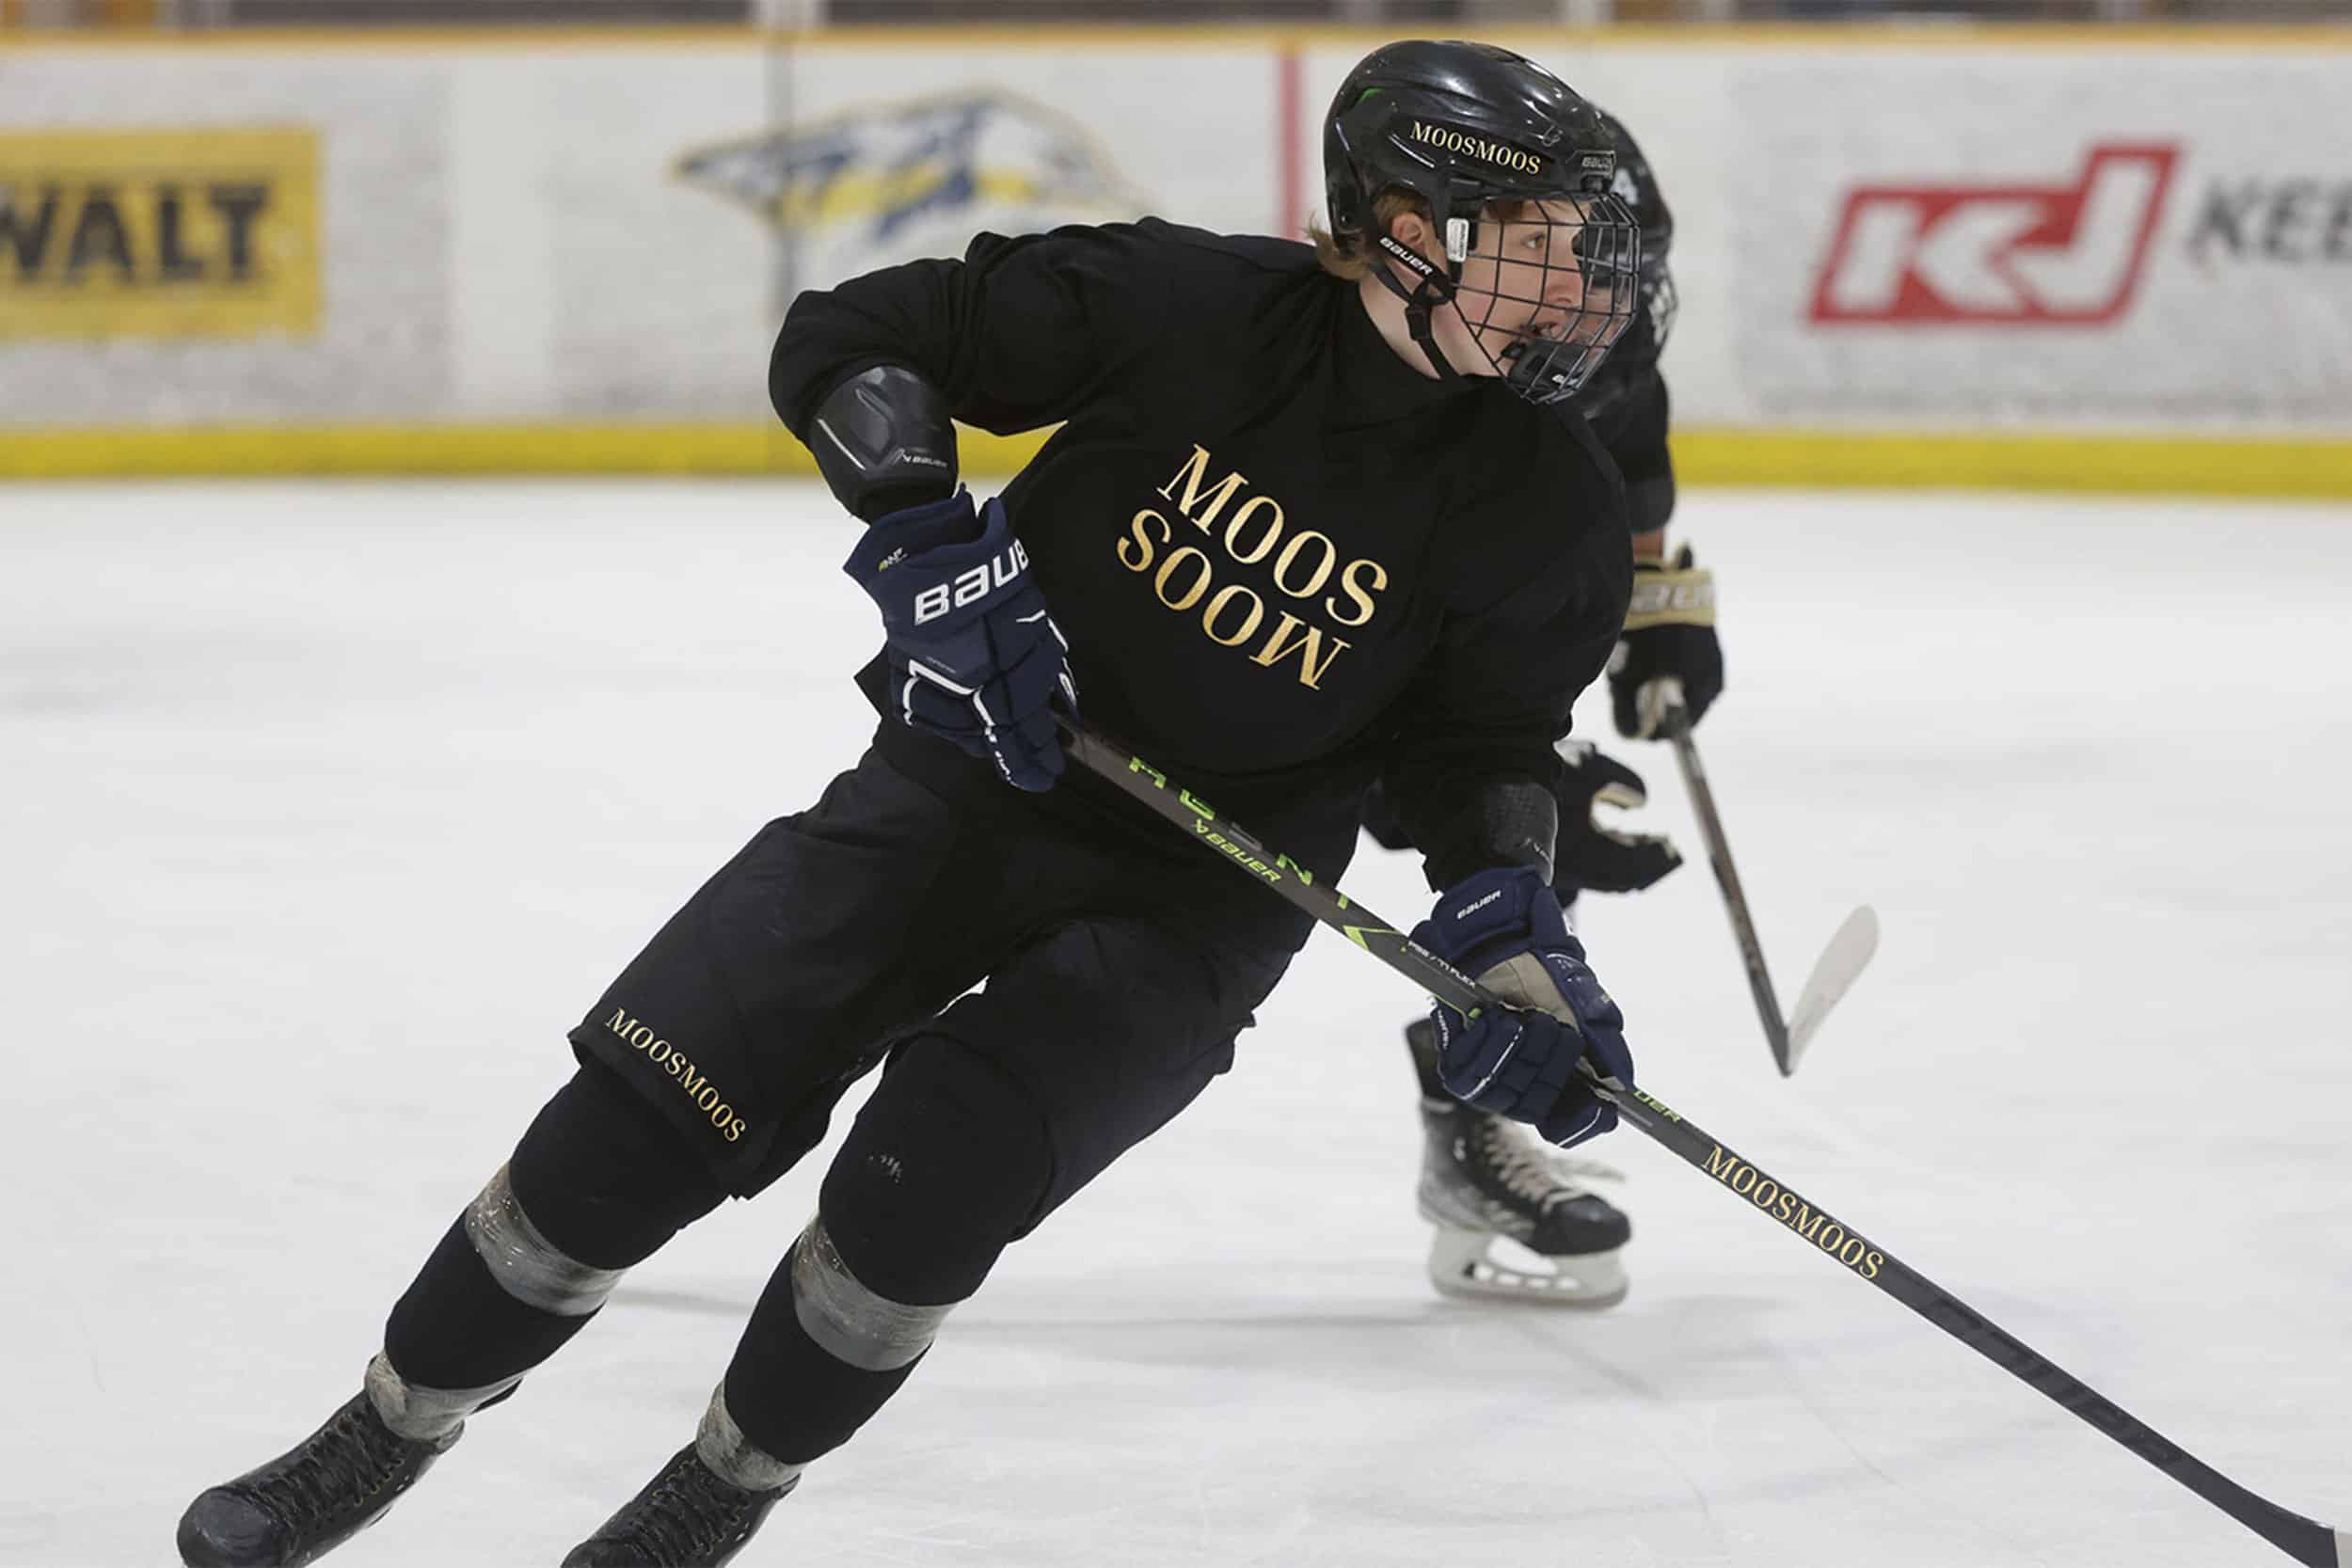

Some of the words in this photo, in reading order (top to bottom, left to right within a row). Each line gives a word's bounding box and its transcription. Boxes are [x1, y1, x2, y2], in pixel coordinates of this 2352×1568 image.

[1409, 120, 1541, 175] MOOSMOOS
[1379, 237, 1433, 276] BAUER
[1156, 443, 1388, 626] MOOS
[1204, 832, 1281, 883] BAUER
[605, 1007, 746, 1143] MOOSMOOS
[1701, 1144, 1884, 1280] MOOSMOOS
